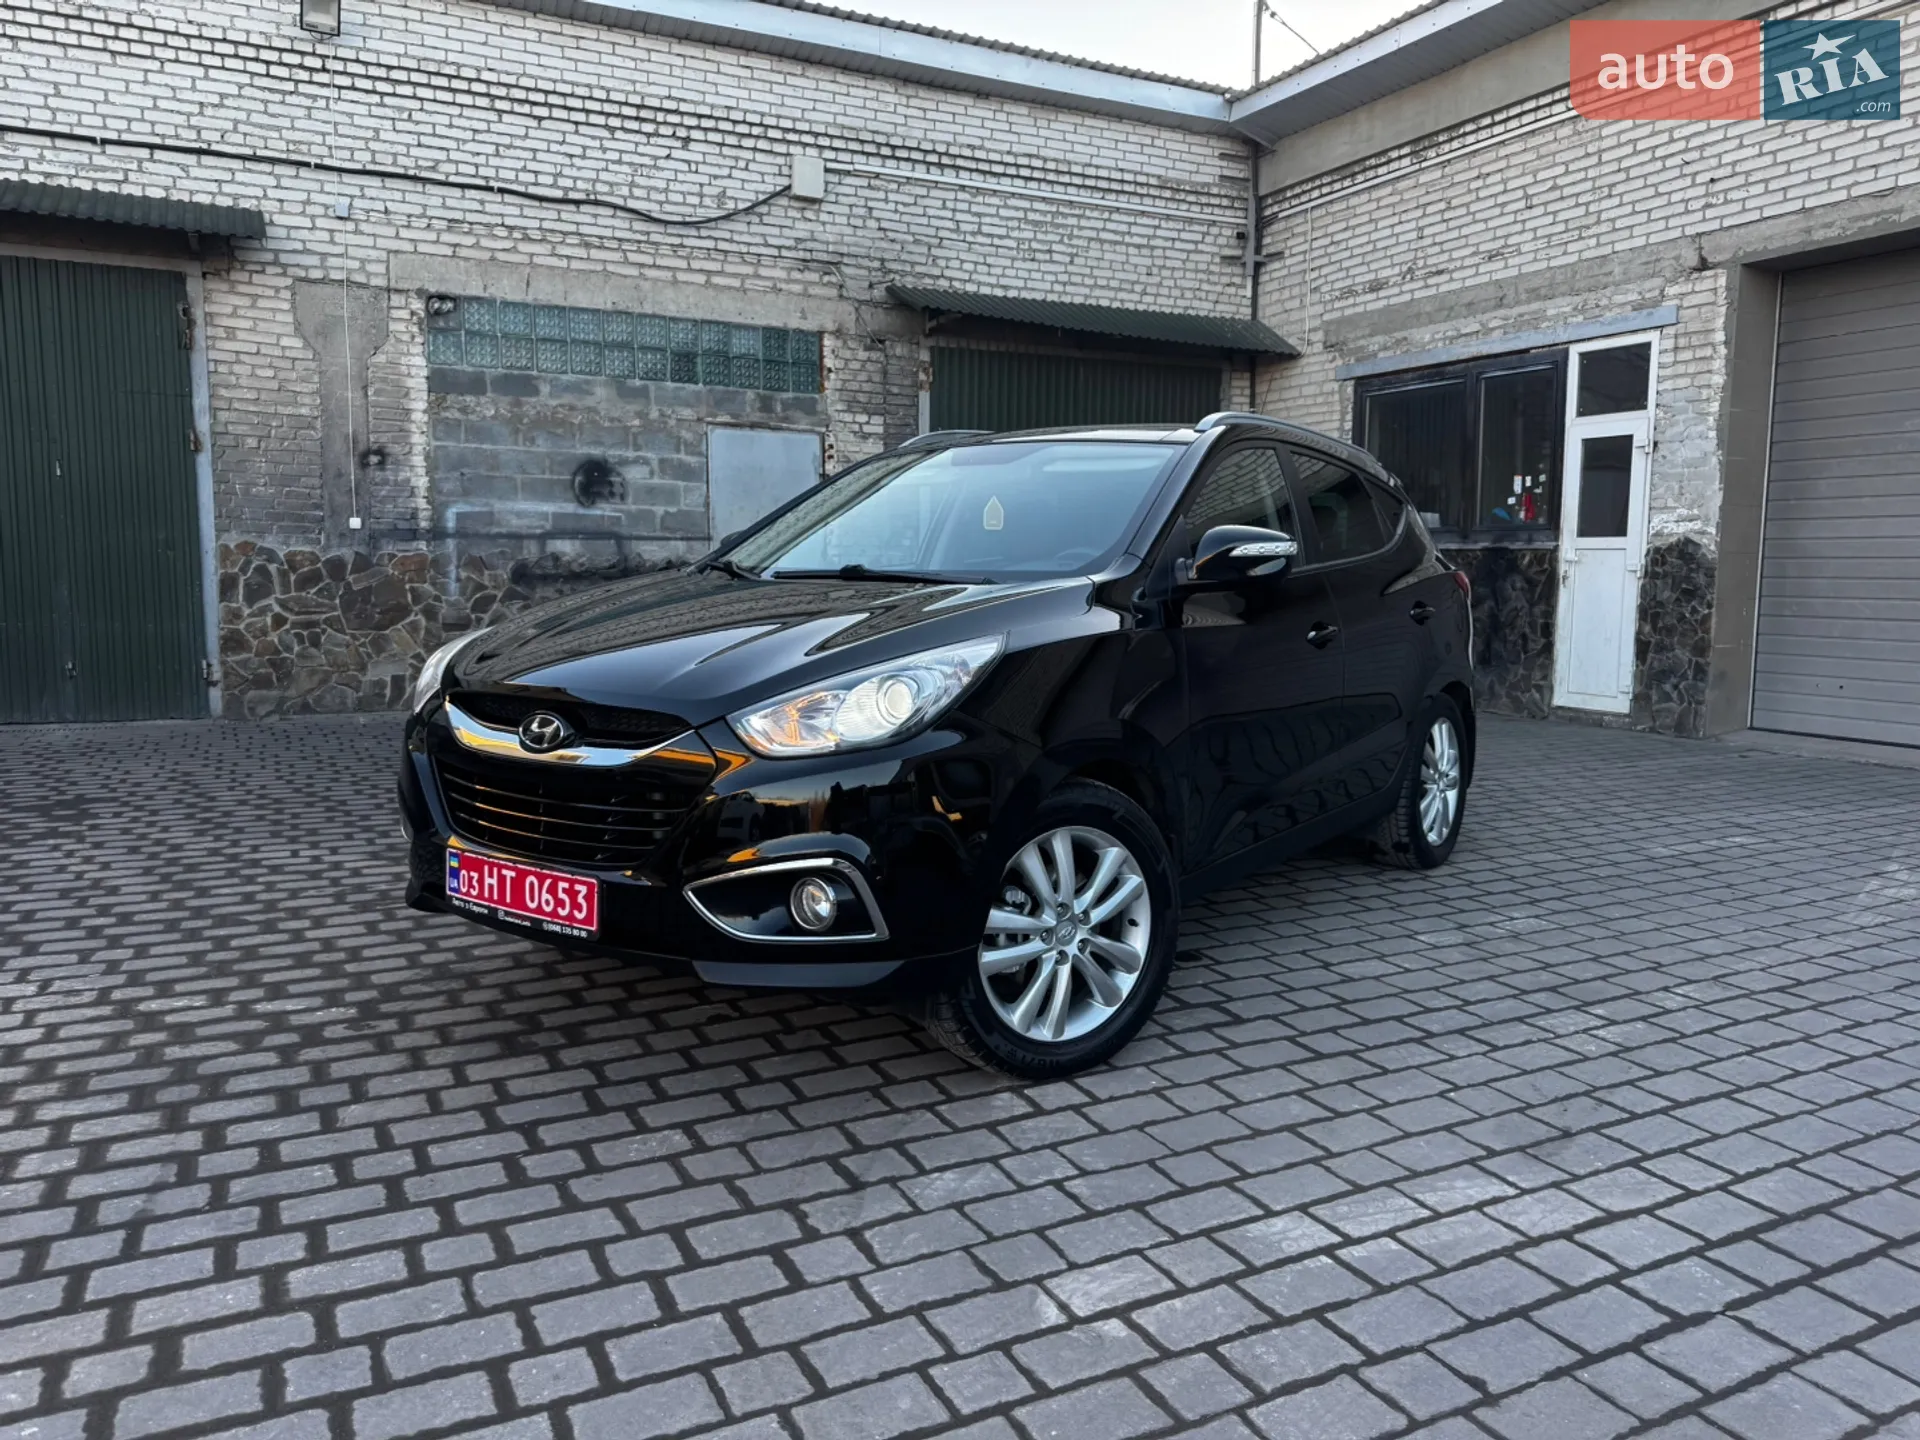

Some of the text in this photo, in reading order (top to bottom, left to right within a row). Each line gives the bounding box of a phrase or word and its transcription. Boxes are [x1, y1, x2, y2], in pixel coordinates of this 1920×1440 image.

[460, 865, 588, 920] 03 HT 0653
